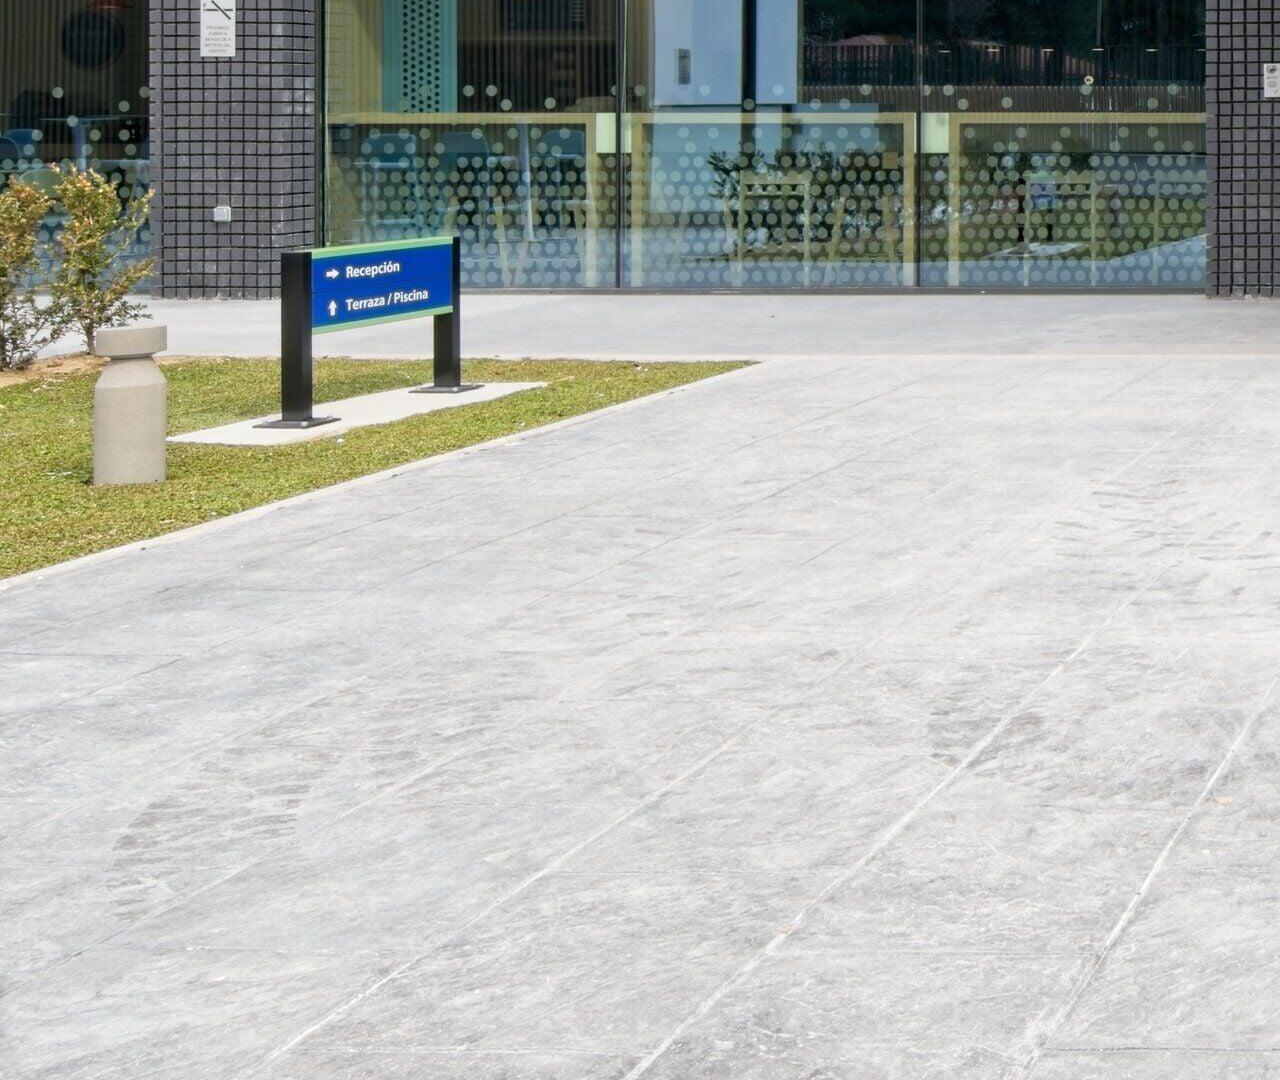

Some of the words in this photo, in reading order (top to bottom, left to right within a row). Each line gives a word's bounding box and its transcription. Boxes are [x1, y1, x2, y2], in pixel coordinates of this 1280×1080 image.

[346, 261, 400, 279] Recepción
[346, 296, 385, 311] Terraza
[393, 289, 428, 304] Piscina
